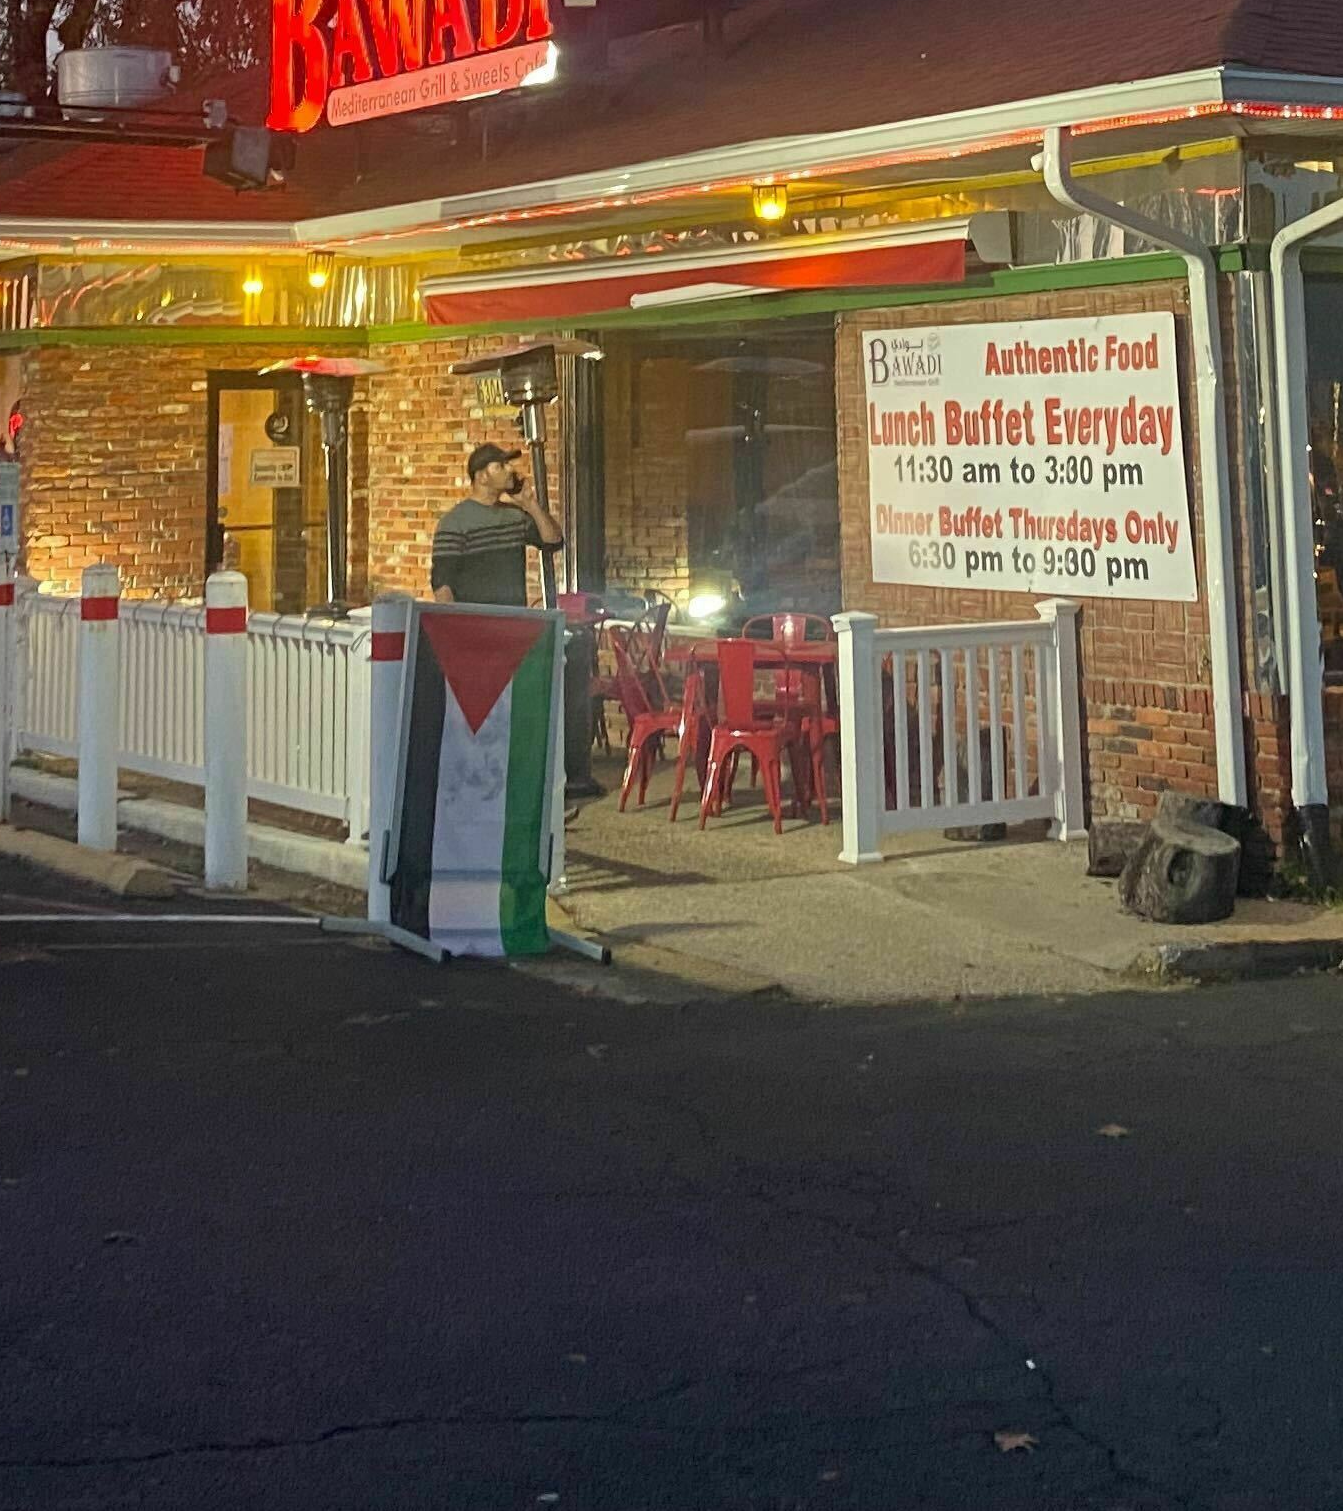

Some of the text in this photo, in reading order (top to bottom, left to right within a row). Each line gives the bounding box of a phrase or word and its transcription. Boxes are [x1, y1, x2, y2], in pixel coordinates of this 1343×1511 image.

[330, 88, 417, 120] Mediterranean
[419, 76, 447, 102] Grill
[450, 72, 459, 91] &
[463, 63, 511, 91] Sweets
[868, 338, 943, 385] BAWADI
[985, 333, 1159, 376] Authentic Food
[869, 396, 1174, 456] Lunch Buffet Everyday
[894, 455, 1144, 493] 11:30 am to 3:30 pm
[876, 504, 1179, 554] Dinner Buffet Thursdays Only
[908, 540, 1150, 586] 6:30 pm to 9:30 pm
